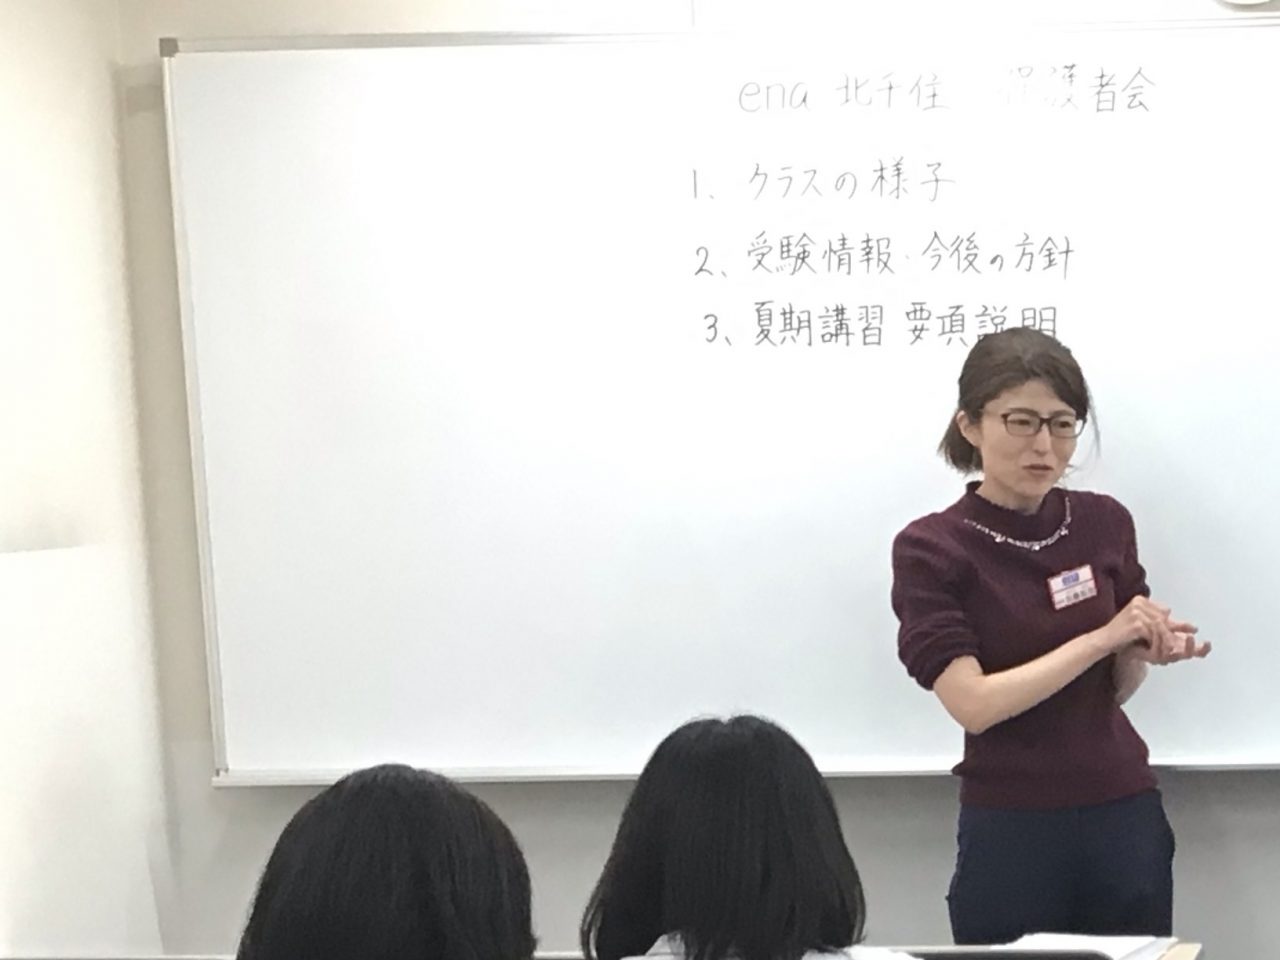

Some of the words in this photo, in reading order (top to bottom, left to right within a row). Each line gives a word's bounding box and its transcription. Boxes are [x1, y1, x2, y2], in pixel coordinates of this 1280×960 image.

[738, 81, 811, 113] ena
[835, 71, 951, 112] 北千住
